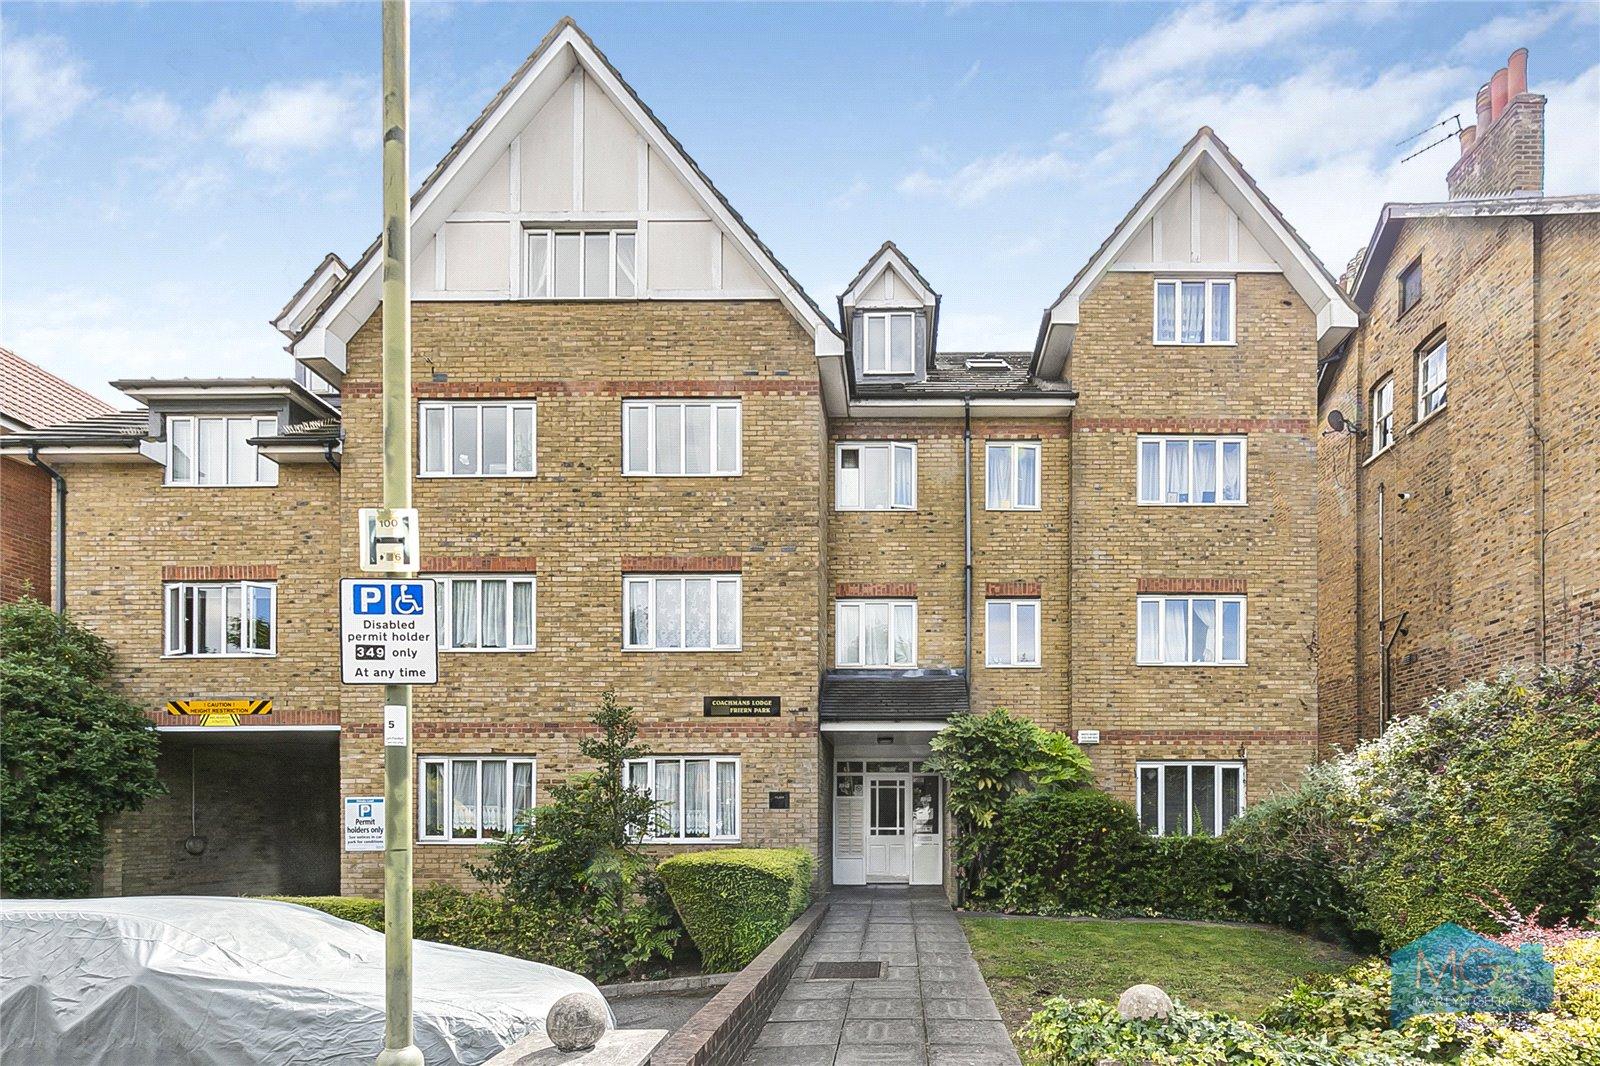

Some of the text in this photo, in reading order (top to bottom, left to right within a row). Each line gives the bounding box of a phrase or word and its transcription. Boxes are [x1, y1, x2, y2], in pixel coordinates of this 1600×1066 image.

[379, 519, 398, 528] 100
[360, 587, 382, 613] P
[363, 620, 415, 629] Disabled
[347, 632, 430, 643] permit holder
[356, 647, 418, 659] 349 only
[355, 668, 426, 679] At any time
[388, 720, 395, 729] 5
[371, 826, 384, 835] only
